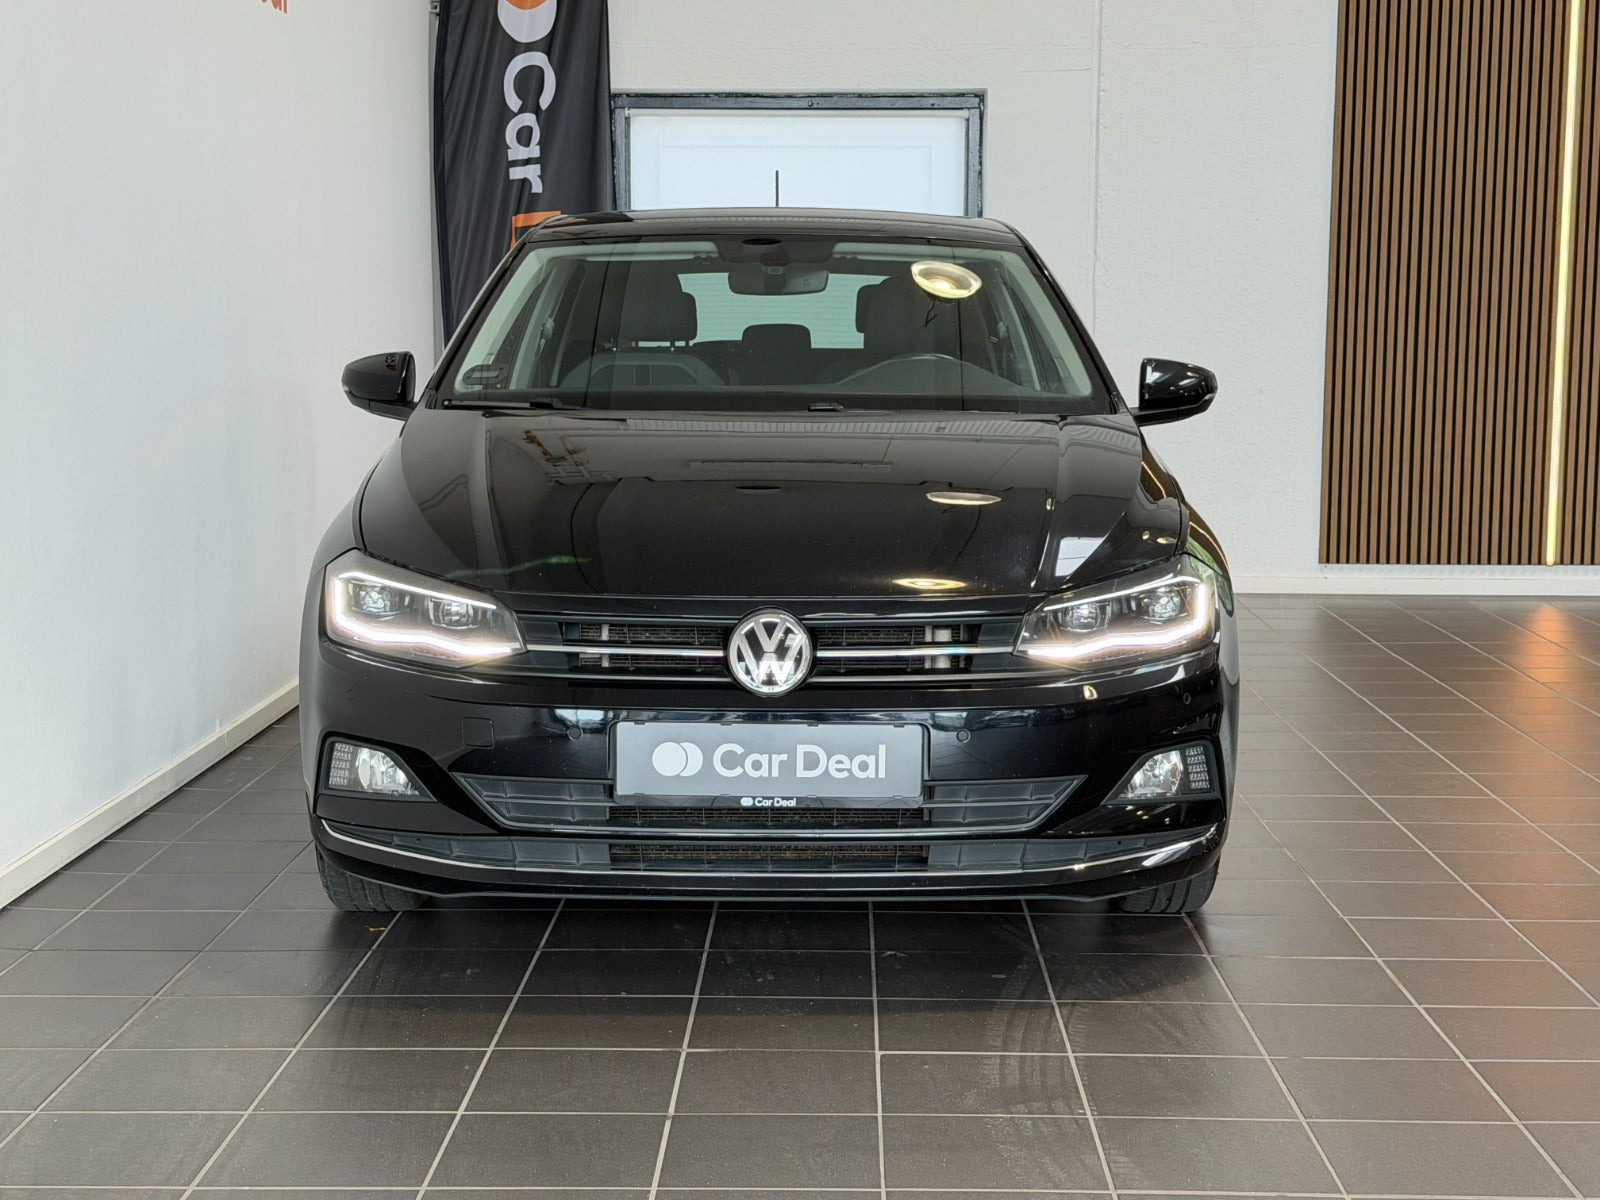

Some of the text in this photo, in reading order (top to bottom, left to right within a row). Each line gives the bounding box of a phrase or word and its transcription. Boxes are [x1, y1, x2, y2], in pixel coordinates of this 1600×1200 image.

[503, 51, 556, 193] Car
[730, 608, 812, 693] VW
[712, 742, 886, 779] Car Deal
[754, 797, 797, 807] Car Deal
